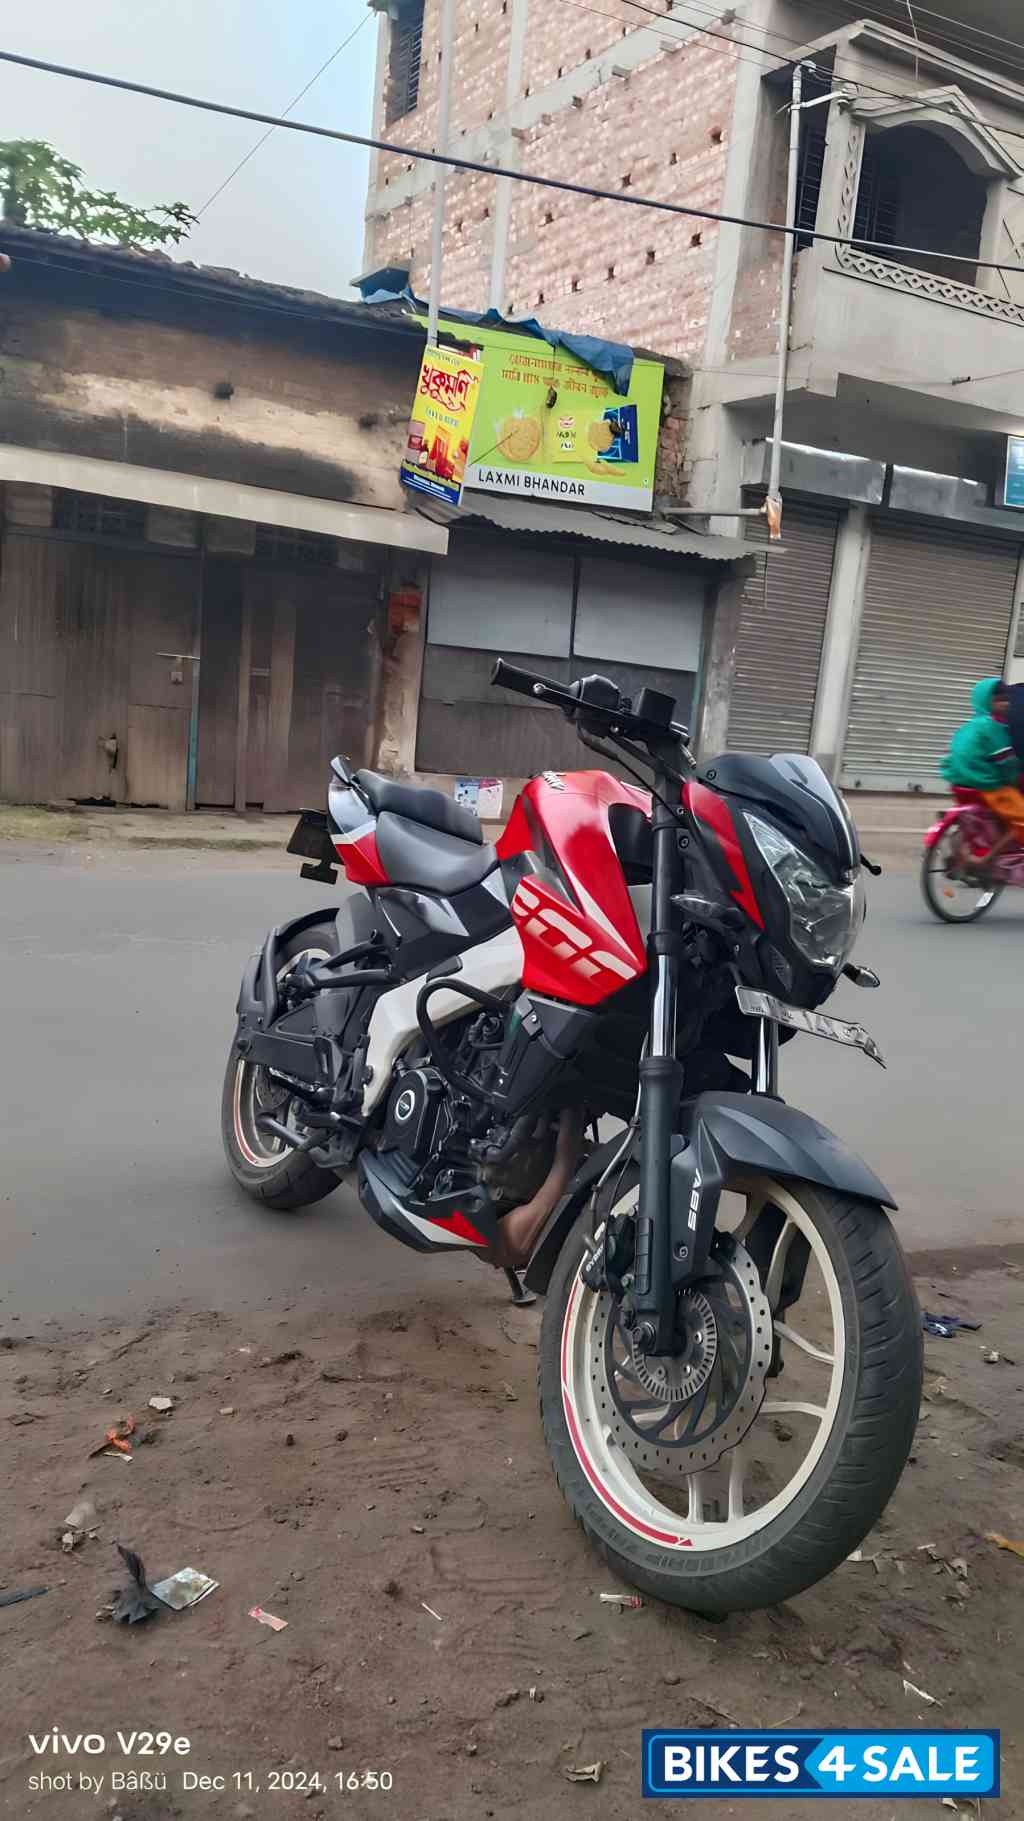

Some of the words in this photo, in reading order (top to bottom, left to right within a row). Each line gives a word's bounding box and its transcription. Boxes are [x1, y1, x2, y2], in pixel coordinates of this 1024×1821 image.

[478, 468, 520, 487] LAXMI
[523, 475, 586, 496] BHANDAR
[687, 1167, 702, 1231] ABS
